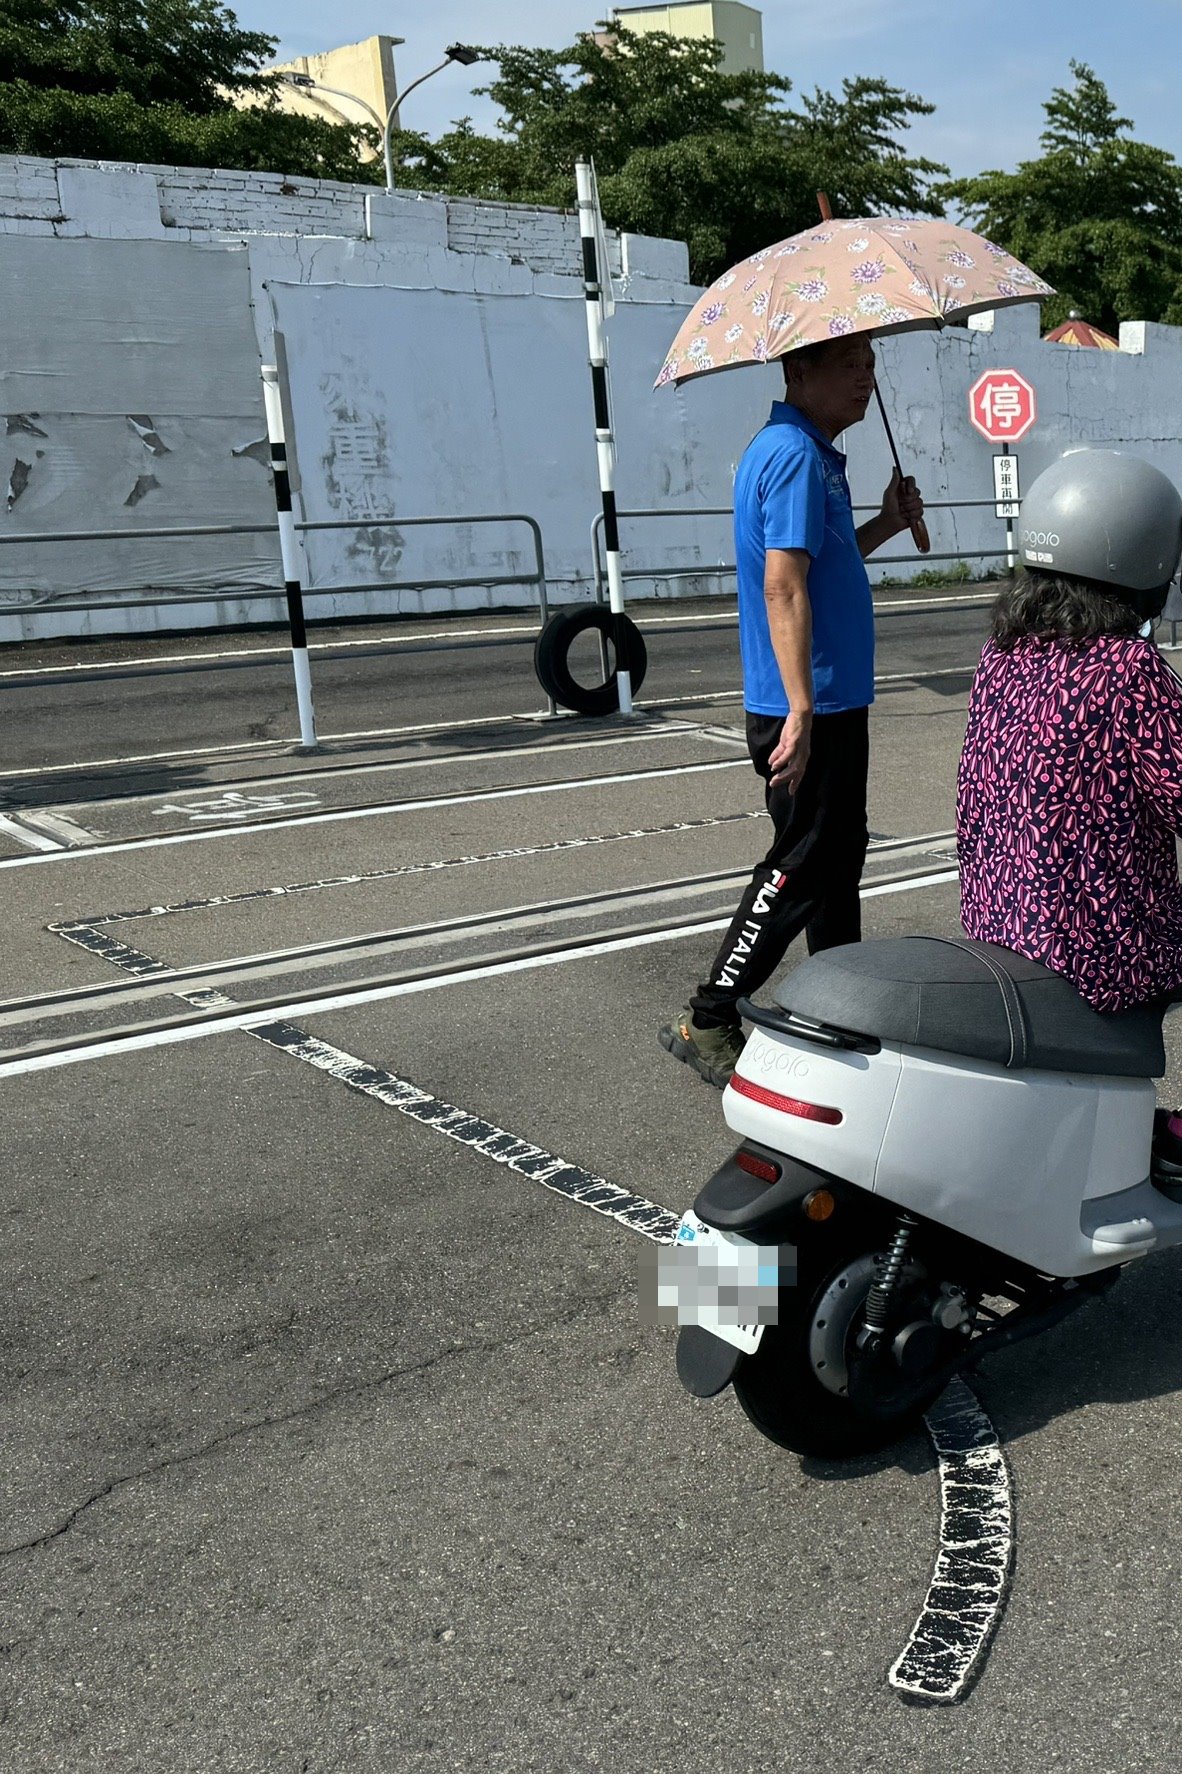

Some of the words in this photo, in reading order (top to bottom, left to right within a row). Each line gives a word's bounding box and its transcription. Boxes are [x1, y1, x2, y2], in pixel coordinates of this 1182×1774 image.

[979, 383, 1022, 429] 停
[1022, 530, 1060, 548] ogoro
[751, 869, 789, 914] FILA
[715, 920, 762, 988] ITALIA
[742, 1036, 811, 1078] gogoro
